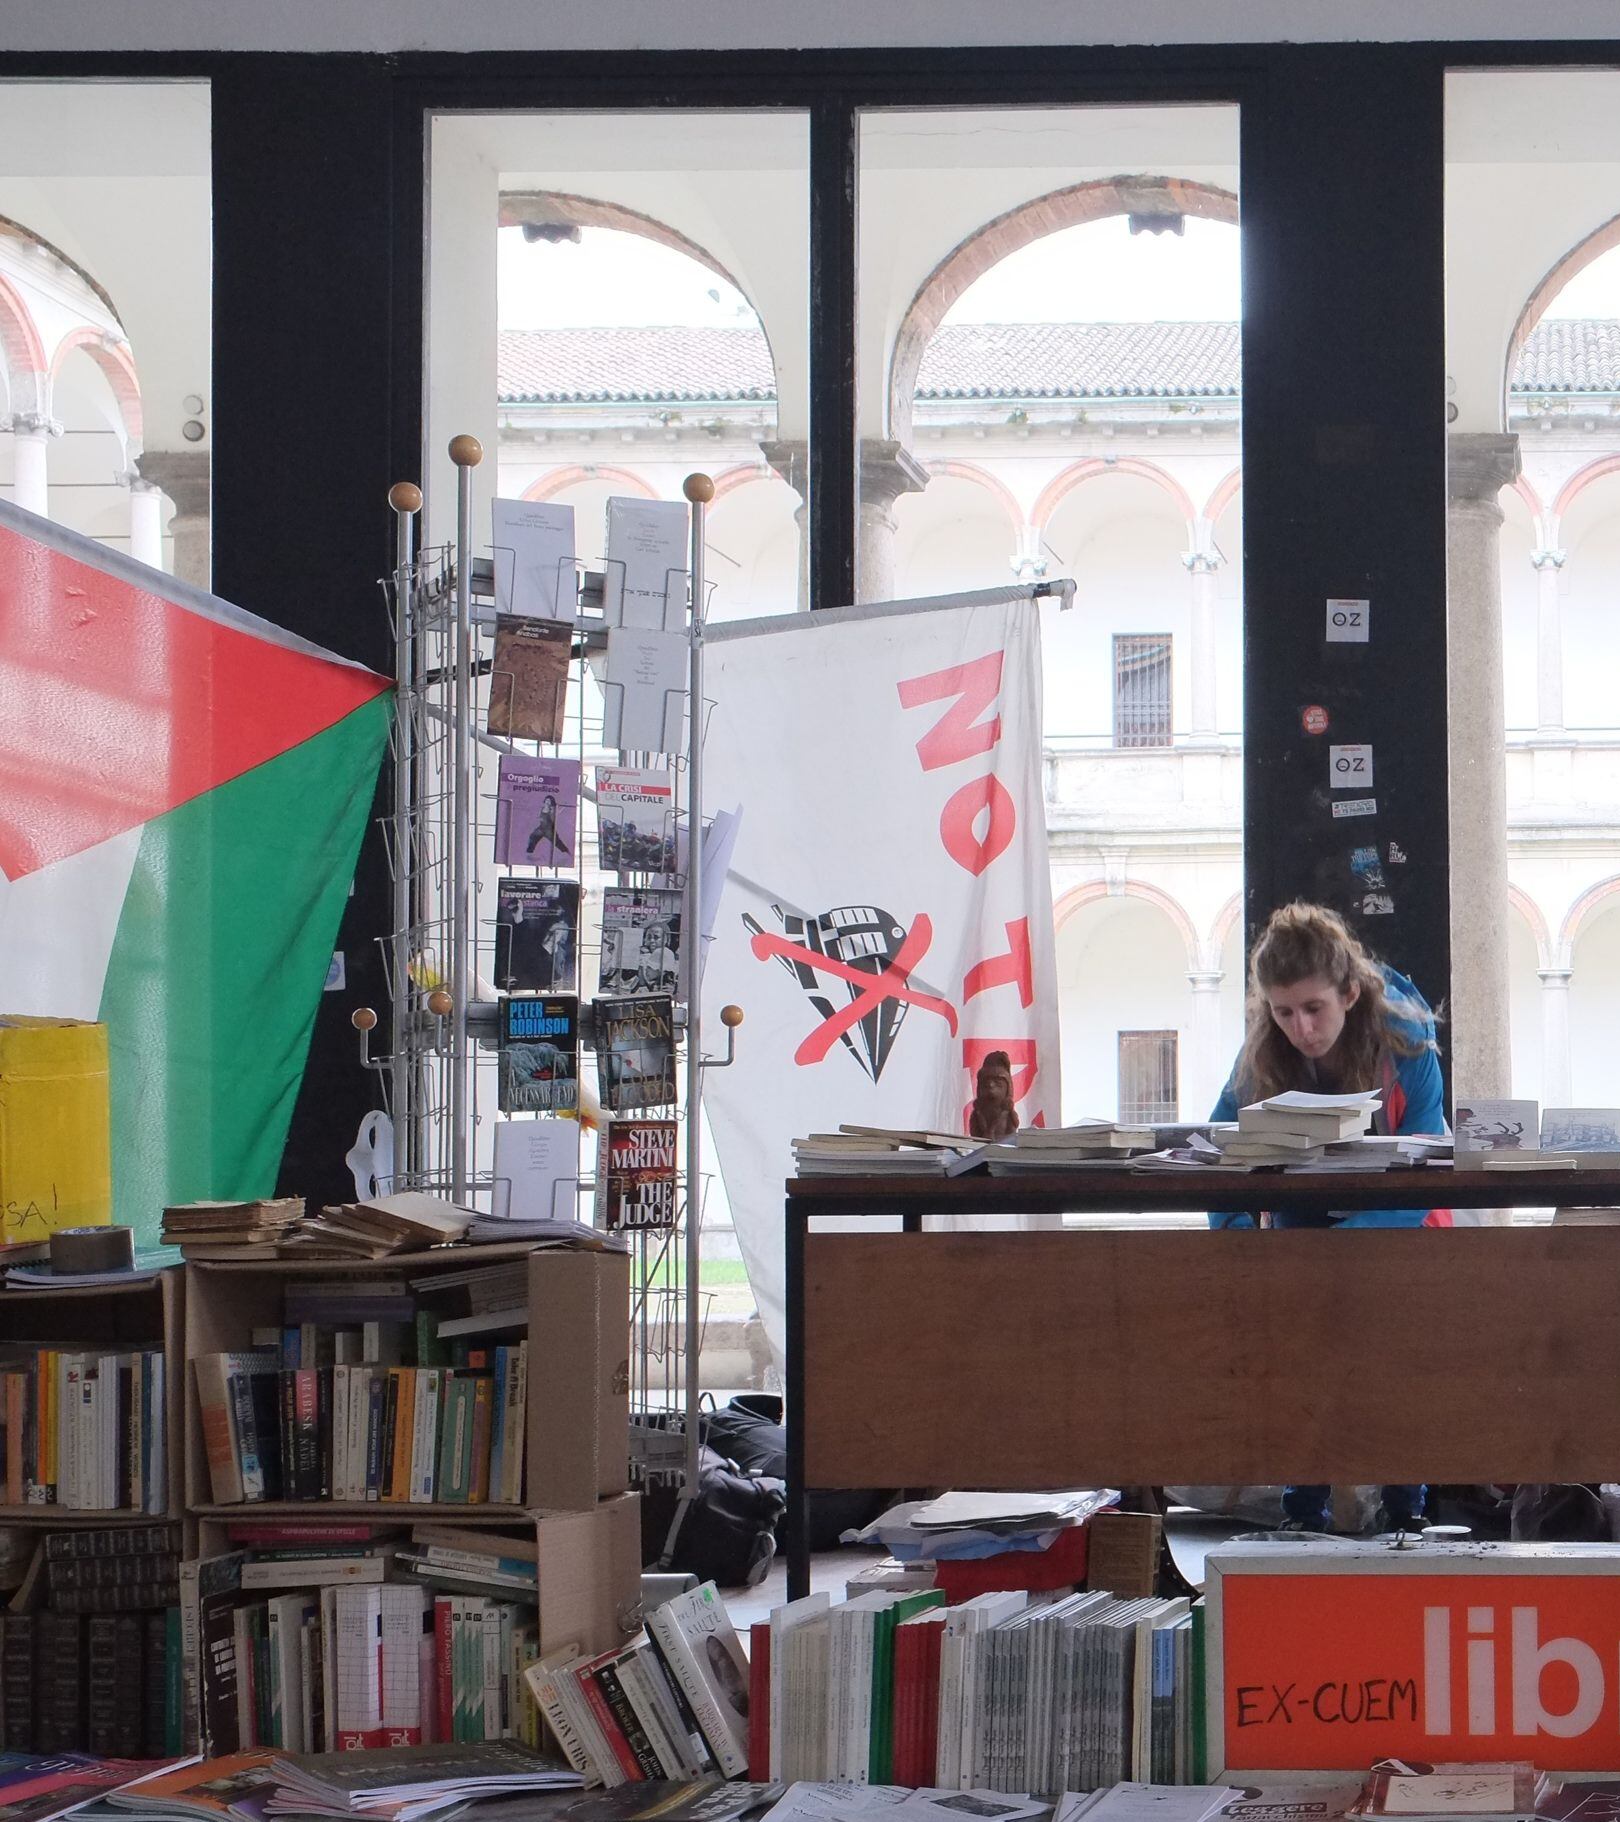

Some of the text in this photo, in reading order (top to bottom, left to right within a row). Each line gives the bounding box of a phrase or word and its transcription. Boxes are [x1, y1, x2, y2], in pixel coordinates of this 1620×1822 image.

[1332, 612, 1361, 627] OZ
[897, 650, 1016, 878] NO
[1336, 757, 1364, 773] OZ
[507, 773, 544, 784] Orgoglio
[605, 783, 642, 793] LA CRISI
[512, 785, 560, 794] pregiudizio
[621, 794, 664, 805] CAPITALE
[500, 889, 542, 900] lavorare
[616, 905, 659, 915] straniera
[509, 1001, 543, 1019] PETER
[618, 1003, 657, 1020] LISA
[509, 1018, 569, 1035] ROBINSON
[605, 1015, 673, 1048] JACKSON
[507, 1086, 554, 1106] NECESSAR
[628, 1129, 675, 1150] STEVE
[611, 1149, 675, 1169] MARTINI
[636, 1182, 673, 1205] THE
[0, 1183, 58, 1227] SA!
[612, 1194, 673, 1230] JUDGE
[302, 1376, 314, 1431] ARABESK
[299, 1437, 310, 1473] NADEL
[444, 1609, 452, 1636] PIERO
[1236, 1679, 1418, 1728] EX-CUEM
[638, 1752, 657, 1781] GRISHA
[648, 1755, 663, 1777] JOHN
[1228, 1802, 1325, 1816] Leggere
